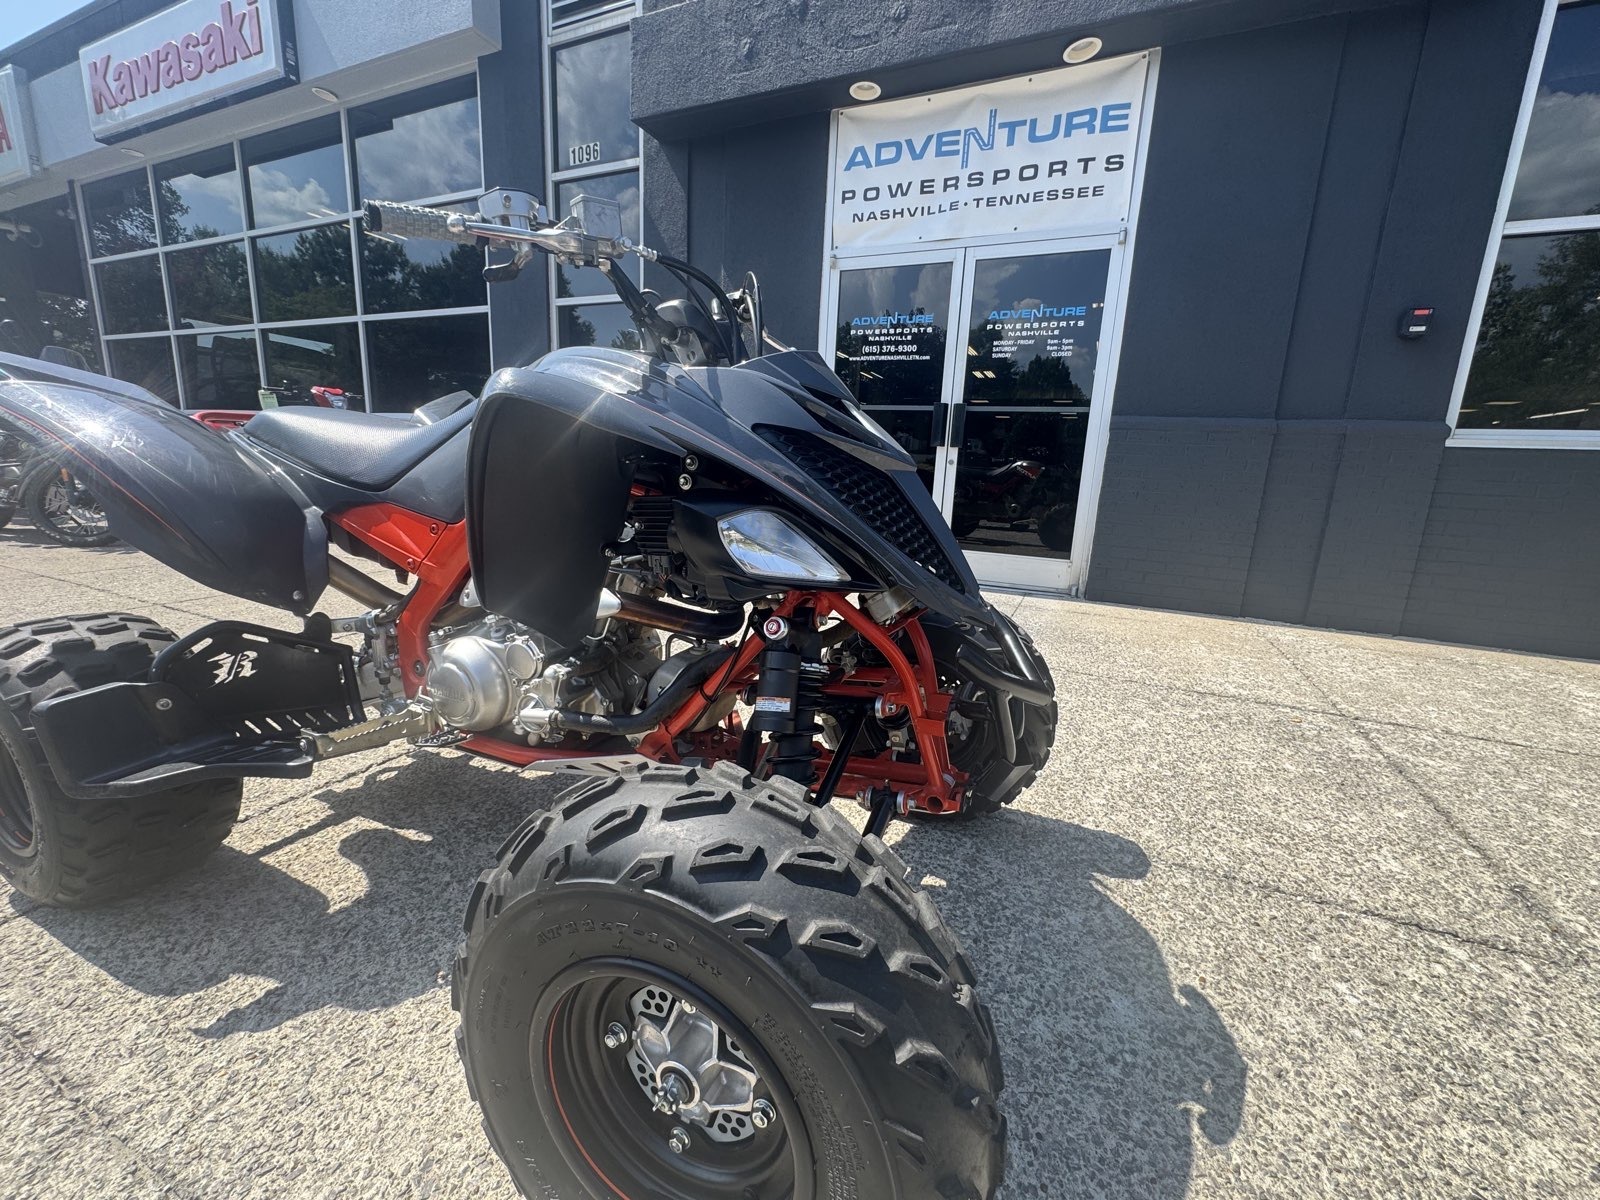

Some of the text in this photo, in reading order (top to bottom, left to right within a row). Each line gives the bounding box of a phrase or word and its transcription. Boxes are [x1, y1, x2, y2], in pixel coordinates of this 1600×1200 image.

[88, 0, 264, 115] Kawasaki
[843, 102, 1132, 171] ADVENTURE
[571, 142, 599, 164] 1096
[841, 154, 1125, 204] POWERSPORTS
[852, 185, 1105, 223] NASHVILLE TENNESSEE
[851, 312, 935, 328] ADVENTURE
[988, 303, 1087, 322] ADVENTURE
[850, 327, 933, 335] POWERSPORTS
[986, 320, 1085, 330] POWERSPORTS
[862, 344, 918, 354] (615) 376-9300
